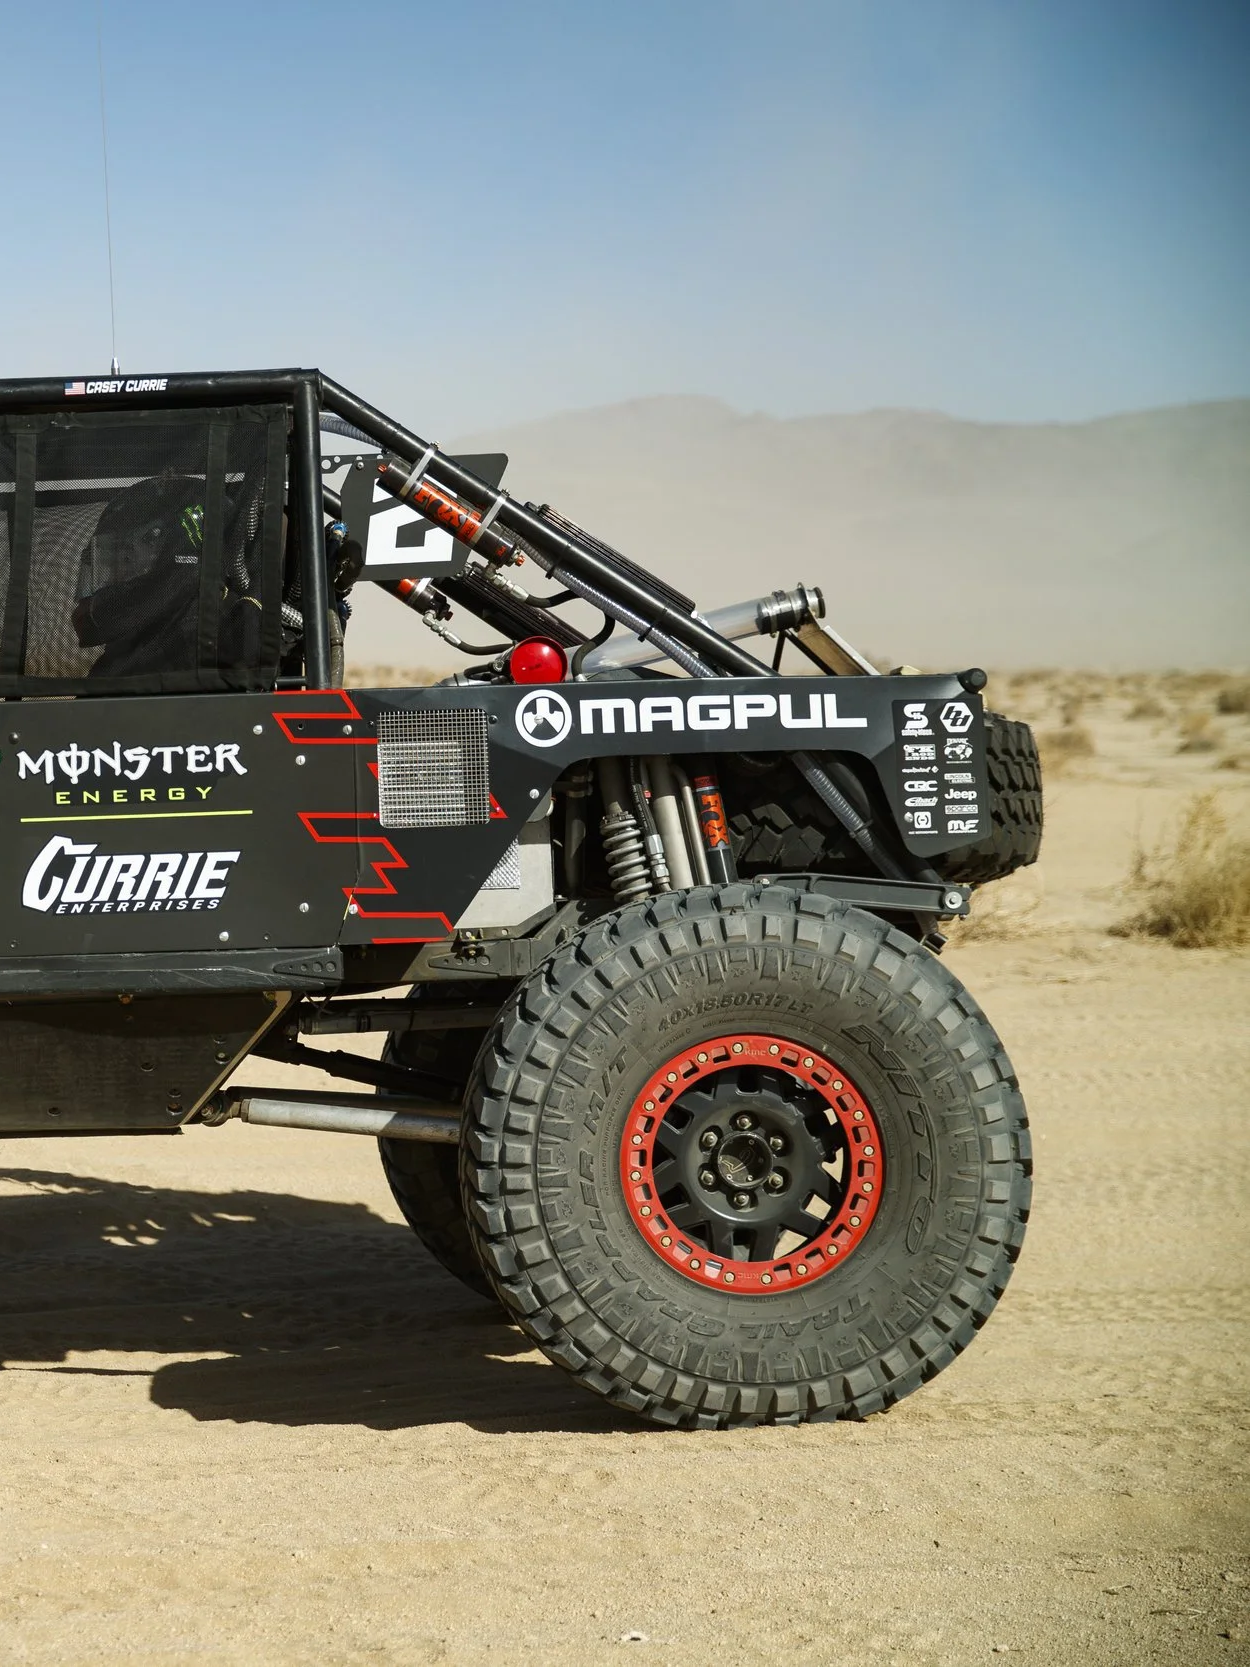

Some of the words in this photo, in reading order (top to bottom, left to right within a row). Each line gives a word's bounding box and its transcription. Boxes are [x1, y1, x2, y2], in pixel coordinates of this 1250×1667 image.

[86, 380, 124, 394] CASEY
[125, 379, 168, 392] CURRIE
[579, 693, 868, 735] MAGPUL
[16, 741, 248, 784] MONSTER
[55, 786, 212, 805] ENERGY
[944, 788, 977, 800] Jeep
[22, 835, 240, 913] CURRIE
[55, 899, 221, 914] ENTERPRISES
[841, 1023, 938, 1255] NITTO
